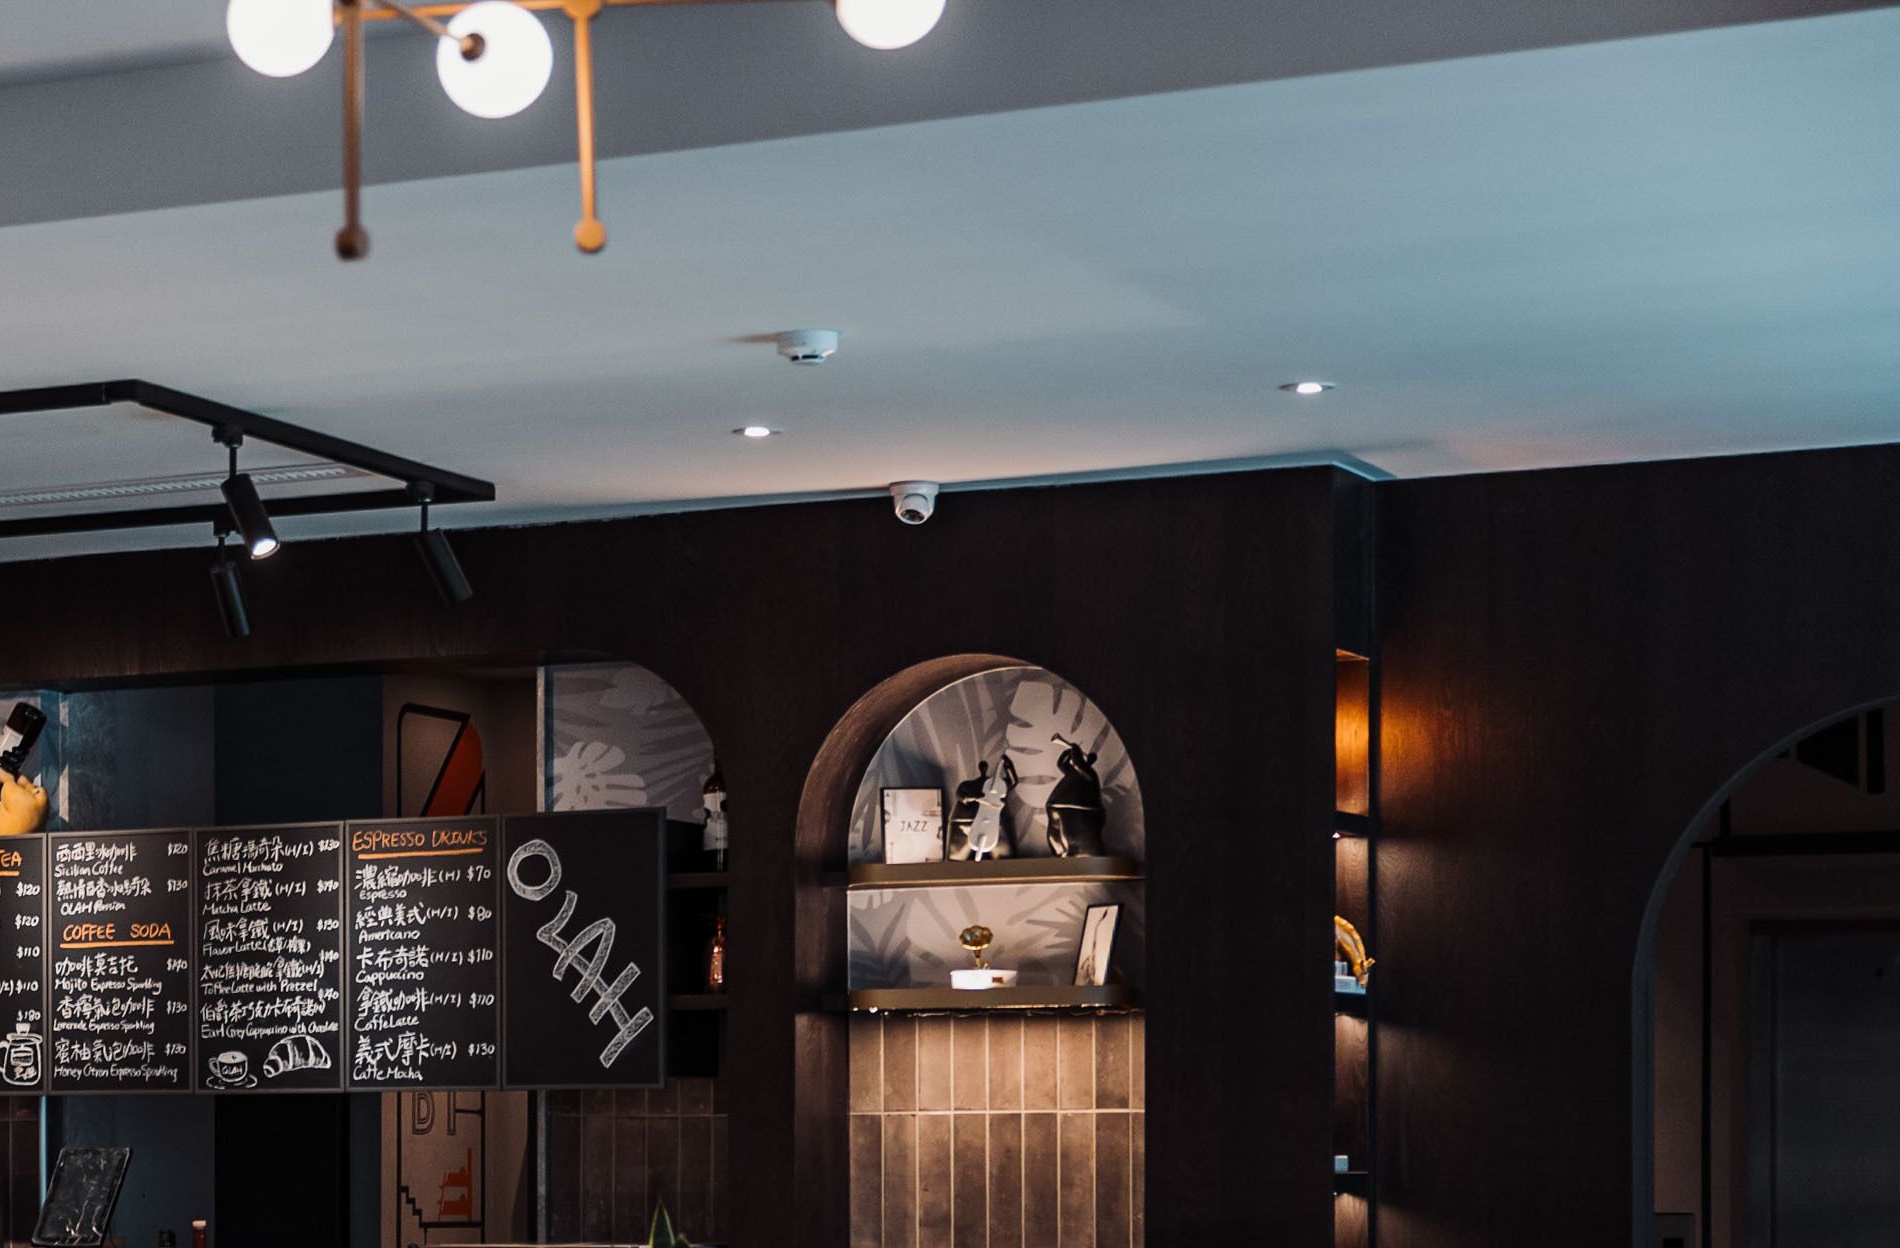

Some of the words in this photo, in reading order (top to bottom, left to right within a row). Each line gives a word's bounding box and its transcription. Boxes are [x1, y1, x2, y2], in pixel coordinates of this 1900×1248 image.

[900, 820, 928, 832] JAZZ
[318, 838, 340, 852] $130
[352, 830, 425, 852] ESPRESSO
[431, 828, 488, 848] DRINKS
[167, 842, 188, 857] $120
[92, 860, 123, 876] Coffee
[202, 861, 241, 876] Caramel
[467, 865, 491, 882] $70
[15, 881, 41, 897] $120
[167, 879, 188, 893] $130
[359, 889, 407, 903] Espresso
[60, 901, 92, 916] OLAH
[202, 903, 239, 916] Matcha
[240, 901, 271, 914] Latte
[468, 905, 492, 921] $80
[15, 914, 40, 930] $120
[316, 918, 340, 932] $130
[62, 923, 115, 942] COFFEE
[130, 922, 171, 939] SODA
[358, 929, 420, 944] Americano
[16, 946, 41, 959] $110
[202, 943, 234, 957] Flavor
[467, 948, 494, 965] $110
[507, 838, 653, 1068] OLAH
[55, 952, 139, 978] 咖啡莫吉托
[15, 979, 39, 994] $110
[54, 978, 87, 994] Mojito
[255, 981, 277, 993] with
[280, 978, 317, 992] Pretzel
[166, 1000, 188, 1015] $130
[469, 992, 495, 1009] $110
[17, 1009, 41, 1022] $180
[201, 1023, 224, 1039] Earl
[289, 1022, 307, 1034] with
[54, 1037, 155, 1064] 蜜柚氣泡咖啡
[165, 1042, 187, 1057] $130
[468, 1042, 495, 1057] $130
[53, 1065, 82, 1081] Honey
[386, 1066, 424, 1081] Mocha
